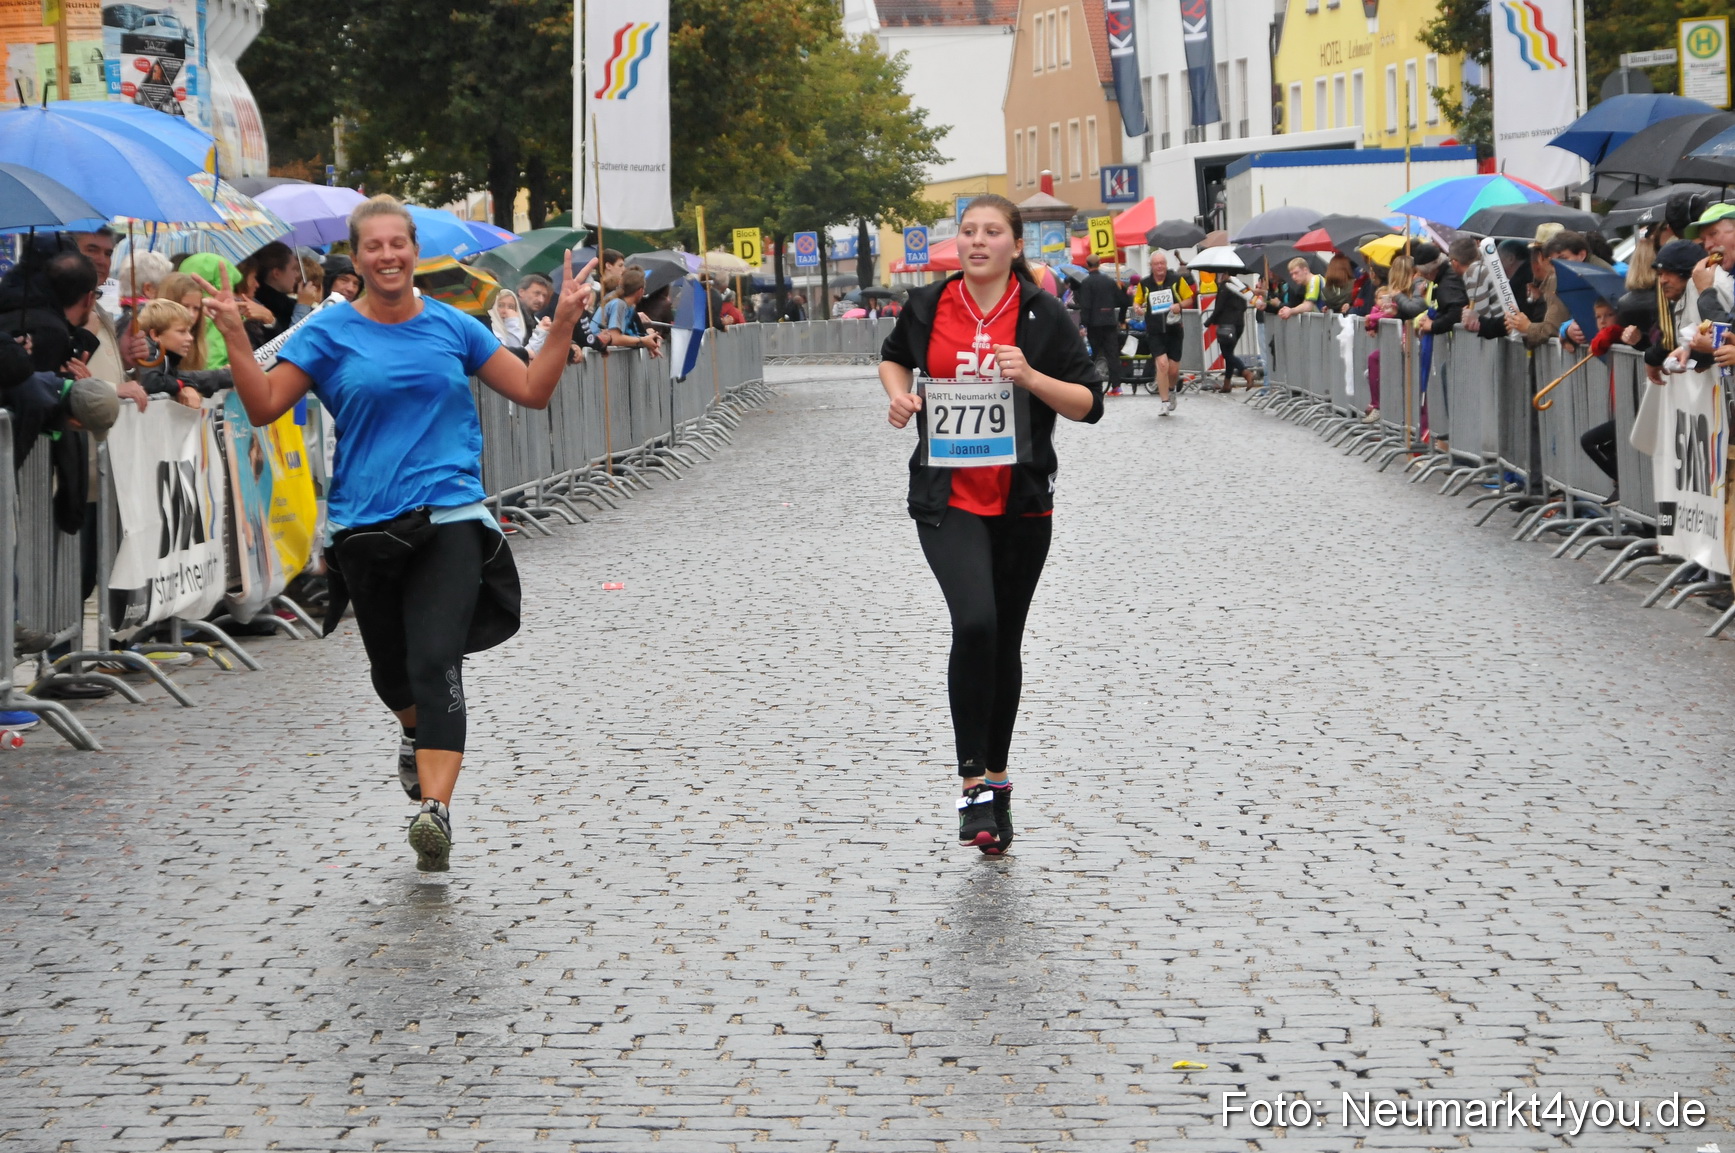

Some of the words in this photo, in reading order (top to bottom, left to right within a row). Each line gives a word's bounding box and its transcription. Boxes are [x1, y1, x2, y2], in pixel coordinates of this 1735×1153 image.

[1320, 40, 1343, 67] HOTEL
[1091, 218, 1111, 227] Block
[736, 230, 757, 238] Block
[1096, 229, 1110, 248] D
[740, 240, 754, 259] D
[798, 255, 816, 263] TAXI
[907, 252, 927, 261] TAXI
[1152, 294, 1171, 305] 2522
[955, 351, 1001, 381] 24
[927, 392, 953, 401] PARTL
[955, 392, 997, 401] Neumarkt
[934, 403, 1006, 435] 2779
[949, 443, 990, 455] Joanna
